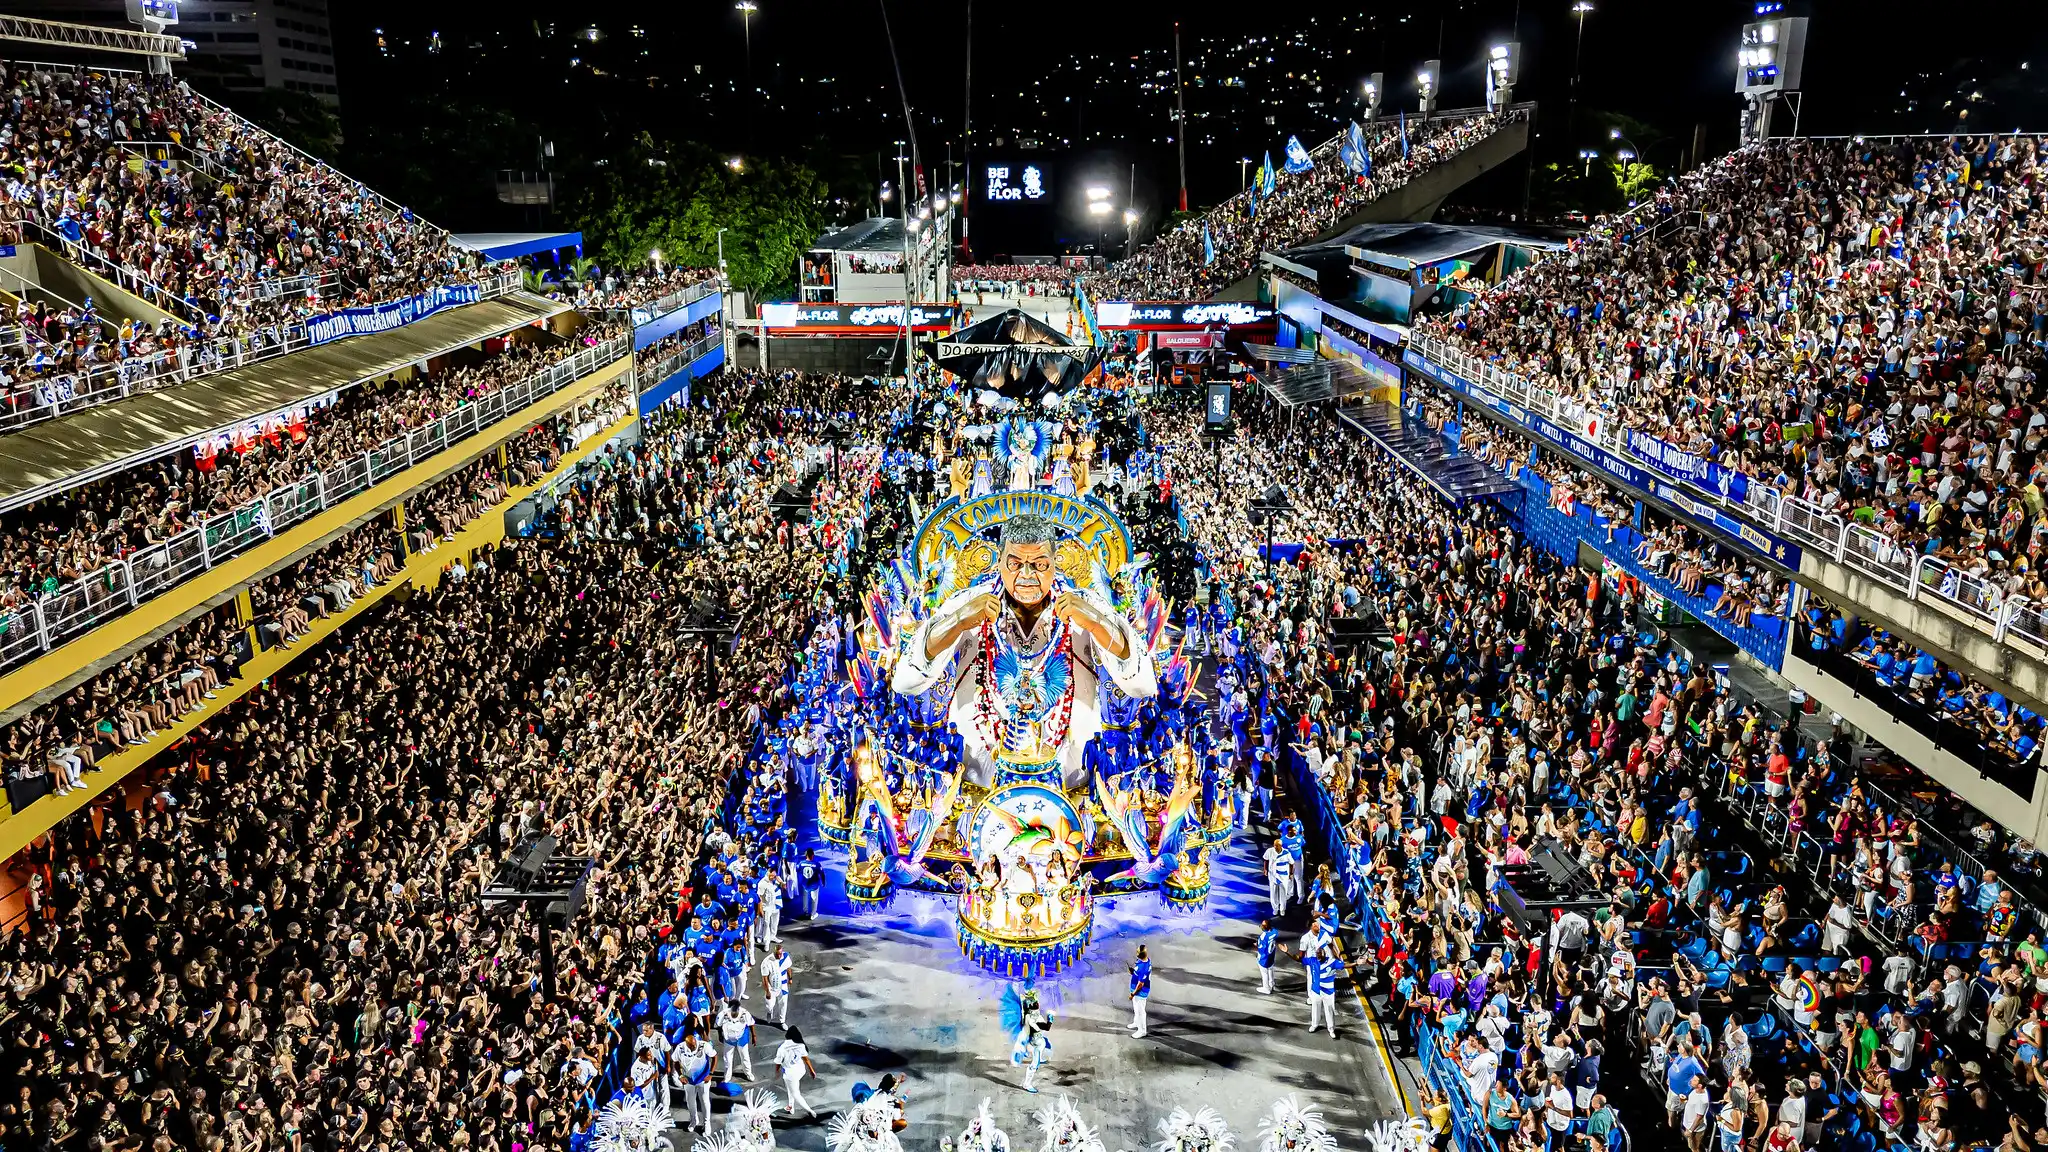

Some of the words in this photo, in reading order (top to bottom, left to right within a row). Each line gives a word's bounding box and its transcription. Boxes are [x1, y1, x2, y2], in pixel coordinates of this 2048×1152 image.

[988, 167, 1009, 179] BEI
[988, 178, 1007, 189] JA-
[988, 188, 1022, 200] FLOR
[352, 309, 402, 332] SOBERANOS
[942, 345, 961, 357] DO
[1541, 422, 1563, 443] PORTELA
[1570, 435, 1595, 461] PORTELA
[1603, 456, 1631, 481] PORTELA
[959, 496, 1092, 532] COMUNIDADE
[1702, 505, 1714, 518] VIDA
[1743, 527, 1750, 539] DE
[1751, 533, 1767, 549] AMAR
